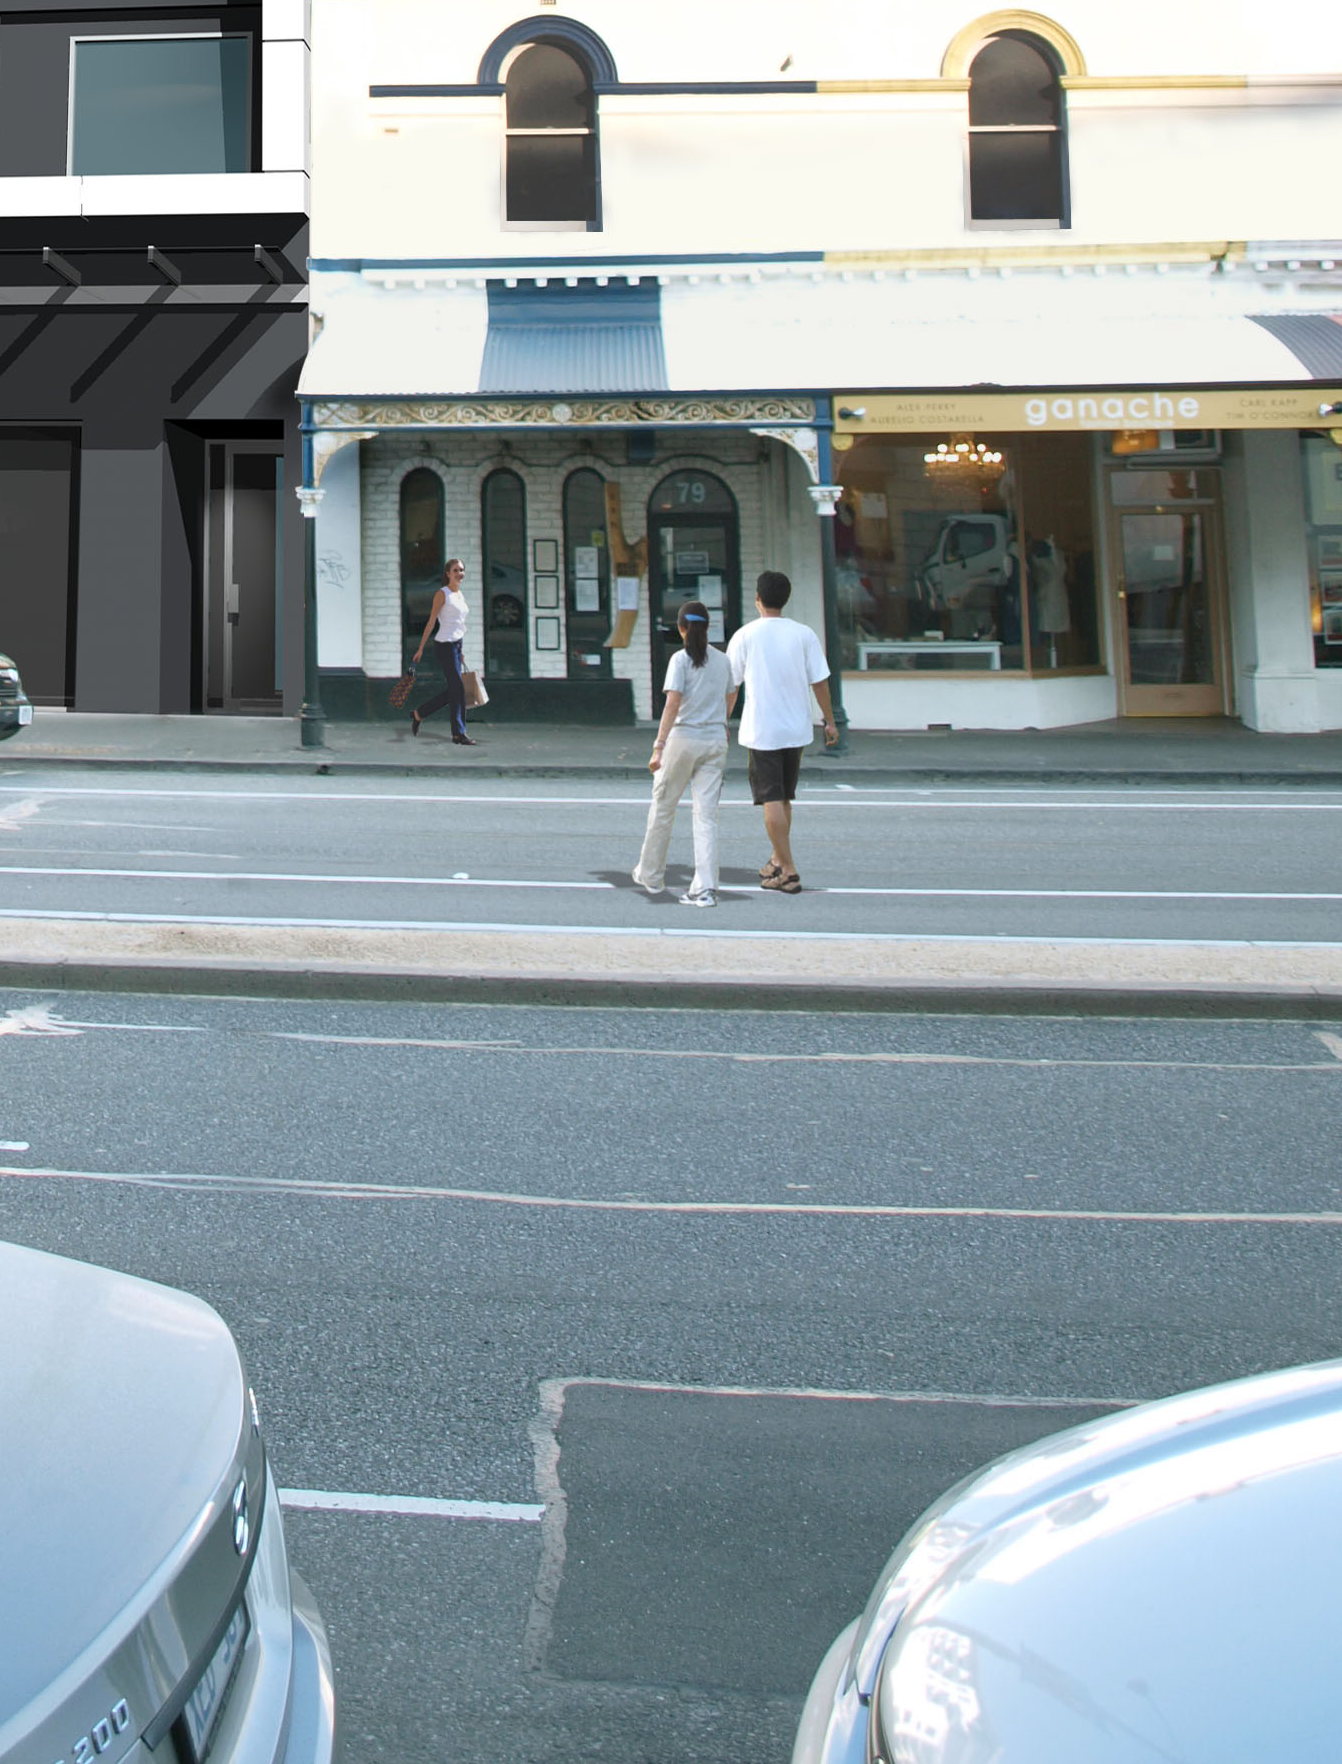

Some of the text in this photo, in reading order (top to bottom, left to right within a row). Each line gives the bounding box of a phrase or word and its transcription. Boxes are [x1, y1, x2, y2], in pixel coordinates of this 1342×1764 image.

[1025, 392, 1200, 427] ganache
[676, 482, 706, 504] 79
[71, 1697, 130, 1764] 200
